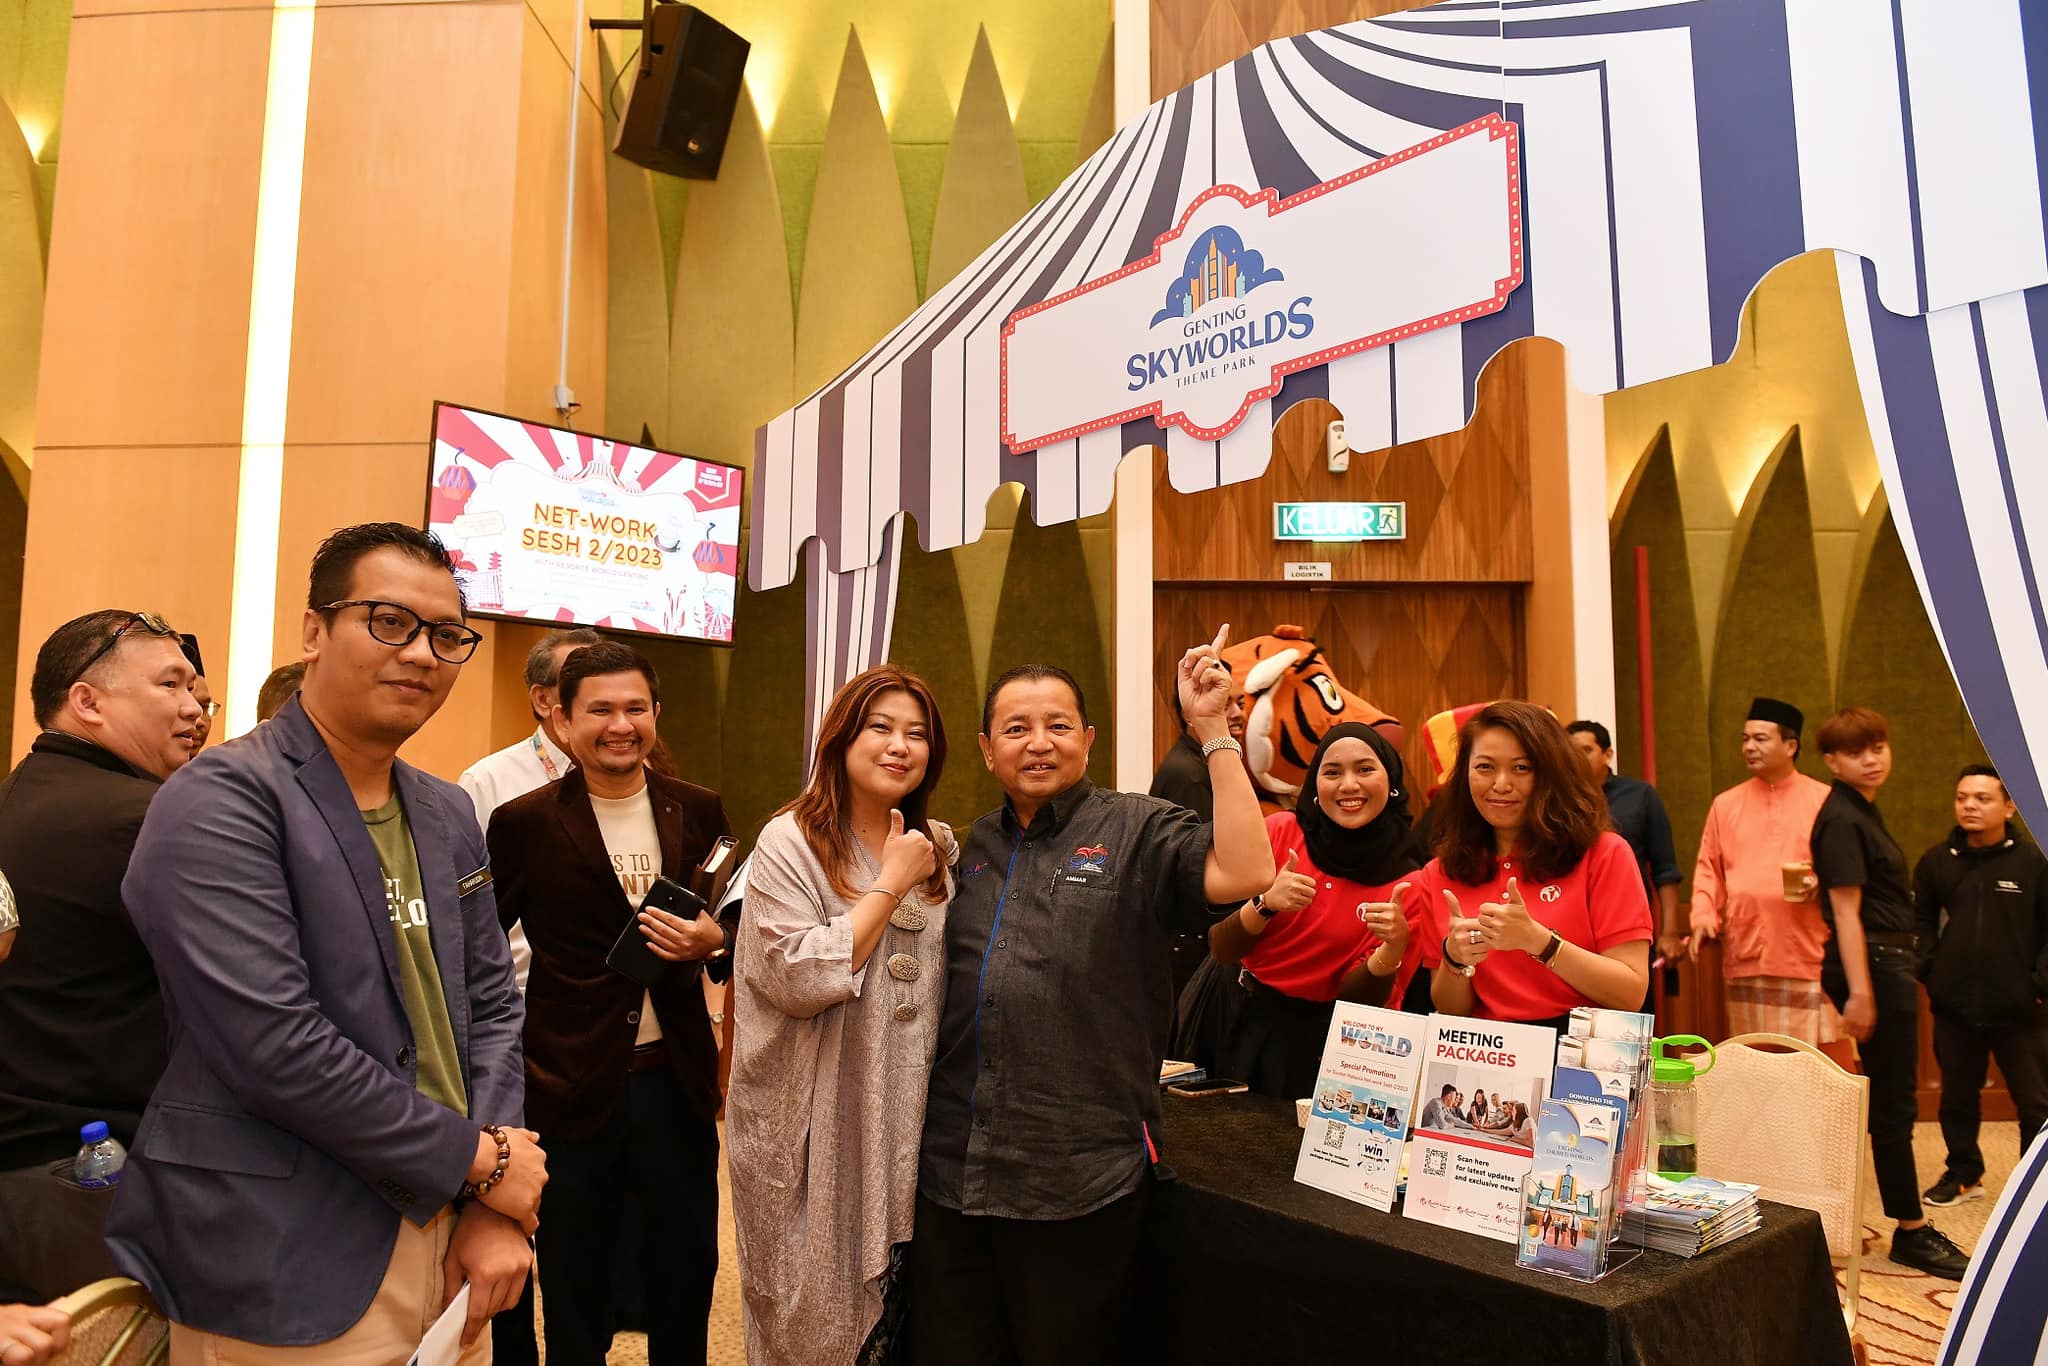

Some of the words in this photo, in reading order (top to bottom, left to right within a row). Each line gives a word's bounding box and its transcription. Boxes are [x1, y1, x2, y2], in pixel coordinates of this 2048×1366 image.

[1183, 303, 1246, 338] GENTING
[1126, 296, 1314, 391] SKYWORLDS
[1175, 368, 1218, 388] THEME
[1222, 355, 1256, 375] PARK
[534, 502, 656, 541] NET-WORK
[1282, 506, 1375, 535] KELUAR
[522, 528, 580, 556] SESH
[588, 539, 663, 568] 2/2023
[628, 854, 651, 871] TO
[617, 873, 661, 895] NT
[1343, 1020, 1367, 1030] WELCOME
[1341, 1025, 1413, 1058] WORLD
[1438, 1028, 1504, 1049] MEETING
[1436, 1044, 1517, 1068] PACKAGES
[1340, 1060, 1361, 1071] Special
[1361, 1065, 1397, 1080] Promotions
[1569, 1092, 1602, 1104] DOWNLOAD
[1364, 1143, 1383, 1156] win
[1457, 1154, 1473, 1164] Scan
[1474, 1158, 1490, 1167] here
[1454, 1174, 1467, 1182] and
[1468, 1178, 1499, 1189] exclusive
[1467, 1166, 1486, 1176] latest
[1487, 1171, 1515, 1183] updates
